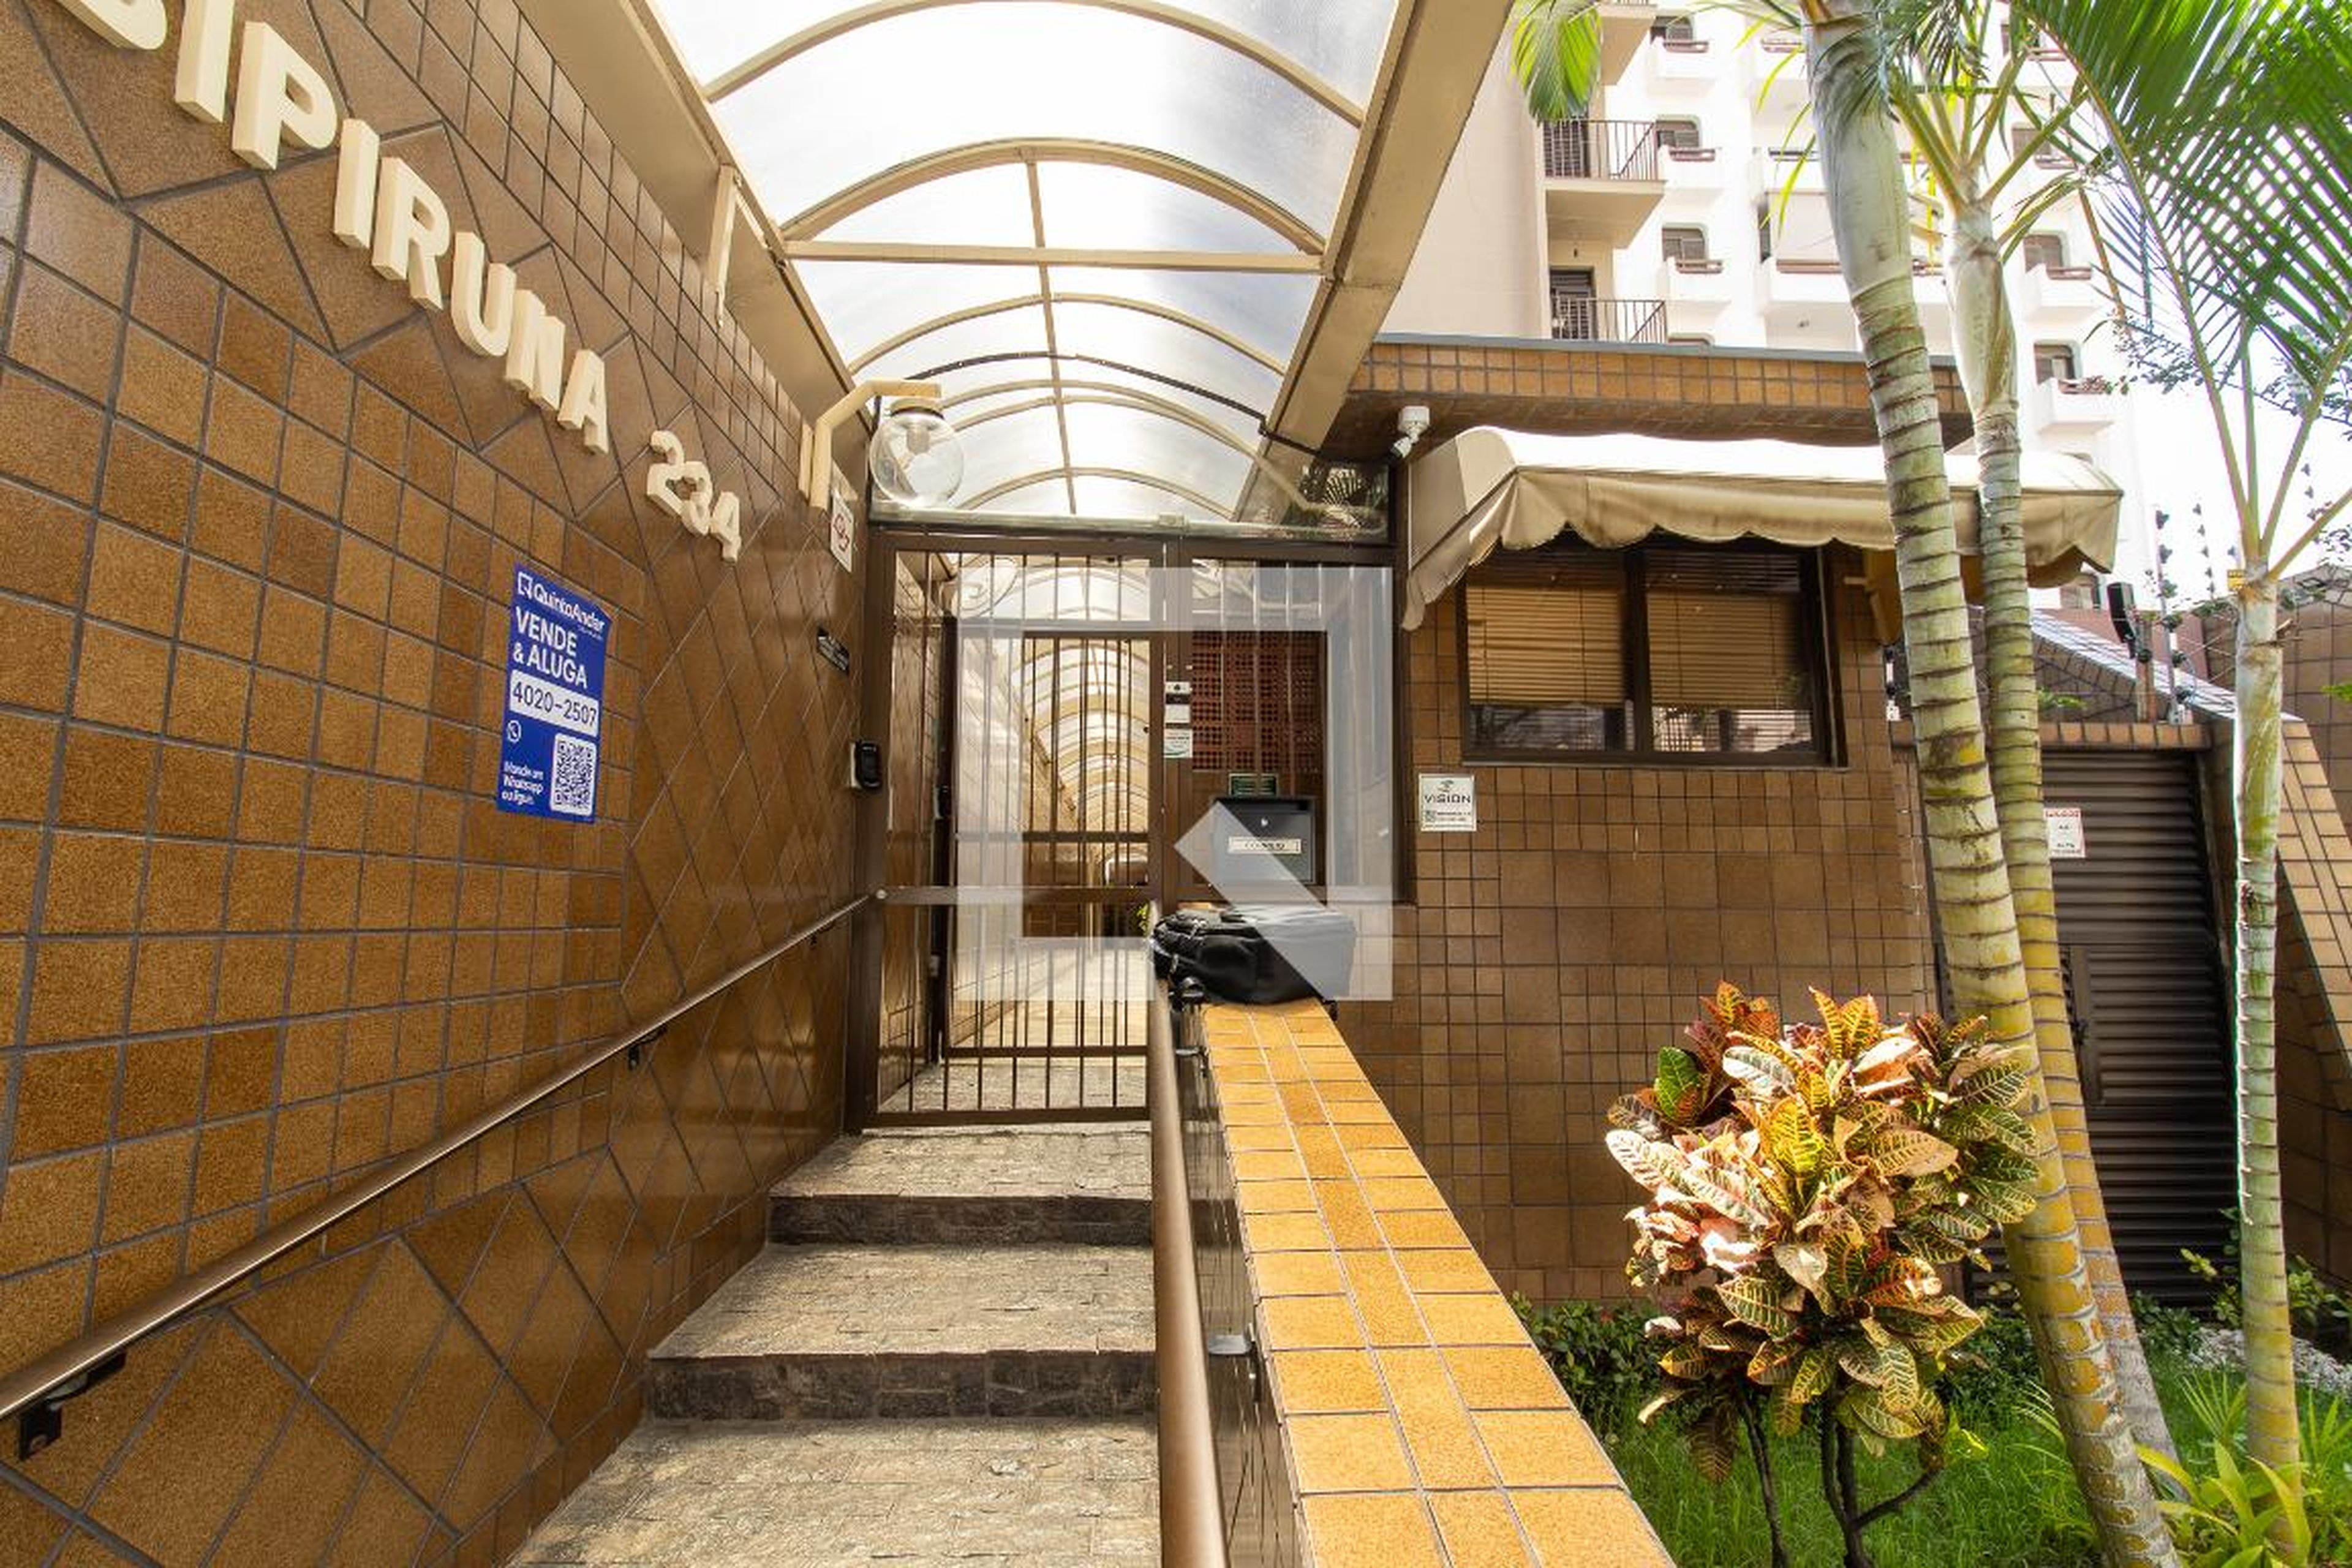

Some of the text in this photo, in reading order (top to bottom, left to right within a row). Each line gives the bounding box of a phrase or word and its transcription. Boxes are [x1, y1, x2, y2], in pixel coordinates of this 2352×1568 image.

[647, 430, 741, 562] 234
[515, 606, 578, 657] VENDE
[513, 643, 587, 689] & ALUGA
[513, 681, 597, 727] 4020-2507
[1425, 794, 1471, 804] VISION
